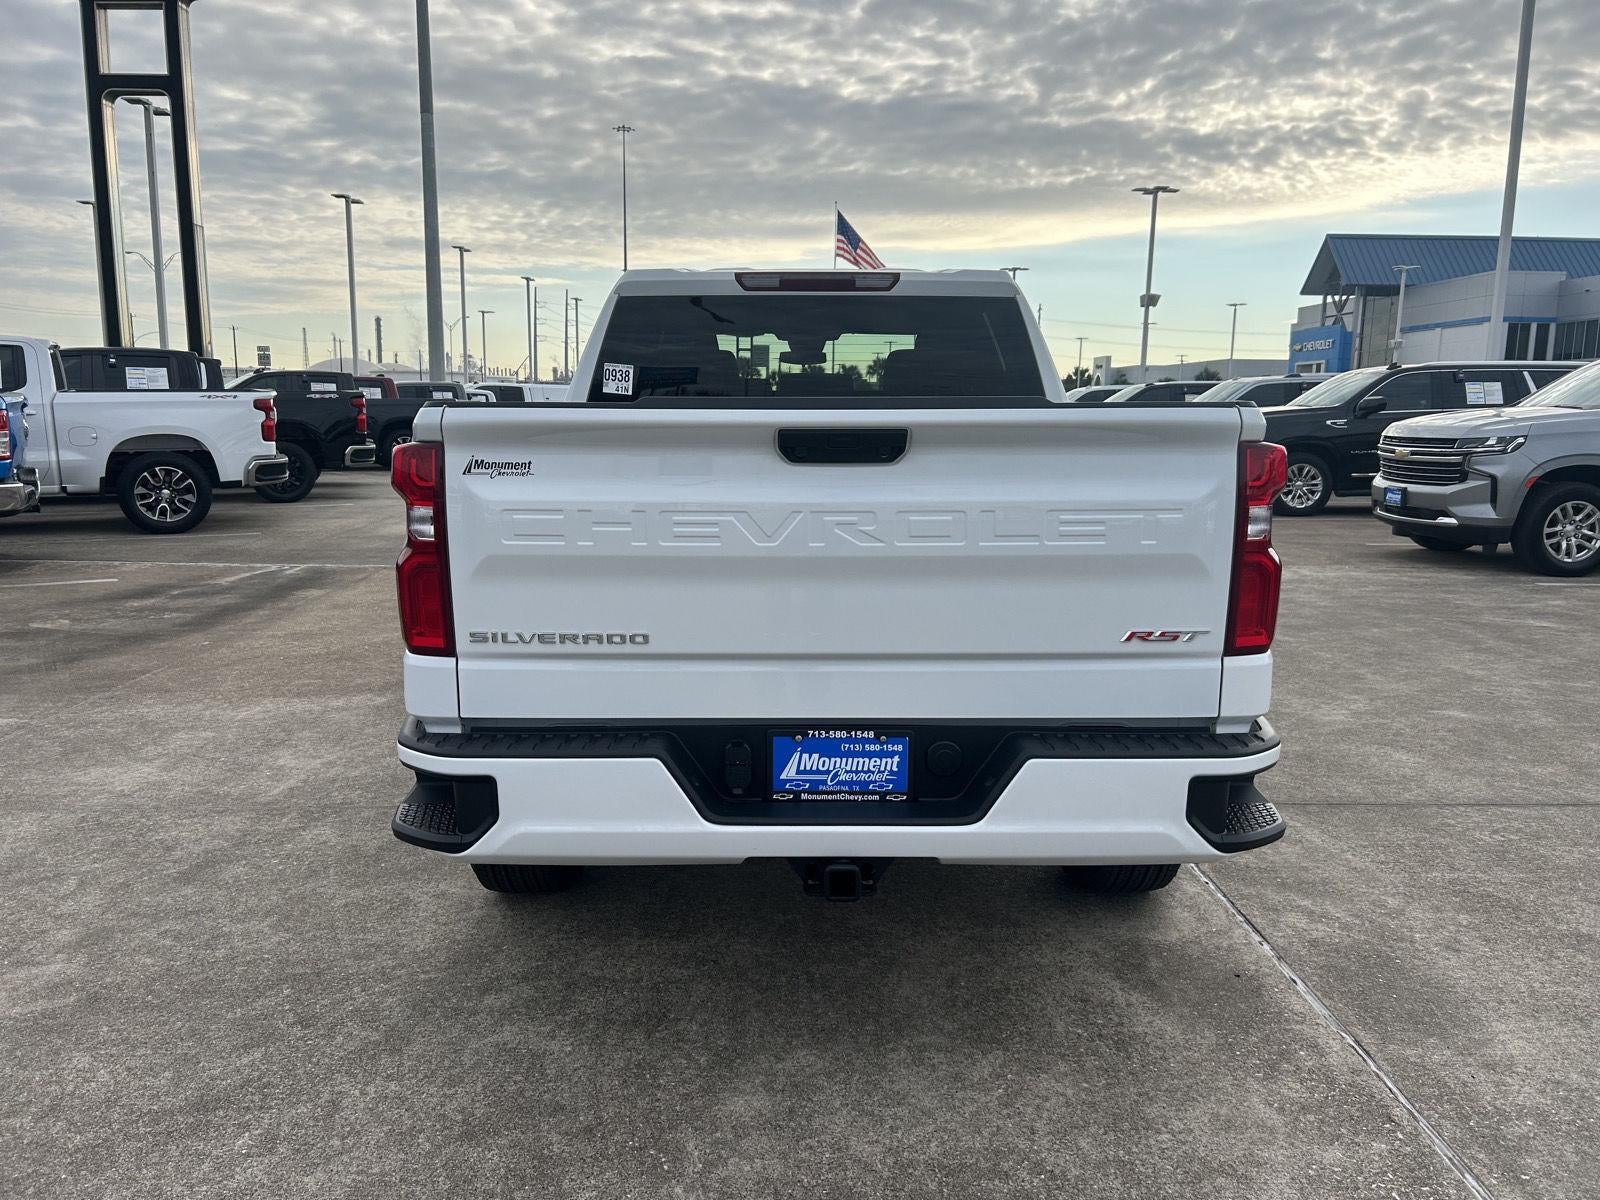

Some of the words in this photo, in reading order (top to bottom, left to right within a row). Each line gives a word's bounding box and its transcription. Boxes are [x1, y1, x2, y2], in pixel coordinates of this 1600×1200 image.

[604, 368, 631, 383] 0938
[615, 385, 629, 394] 41N
[473, 459, 533, 471] Monument
[490, 468, 534, 480] Chevrolet
[500, 508, 1185, 546] CHEVROLET
[469, 631, 650, 645] SILVERADO
[1120, 630, 1211, 643] RST
[807, 730, 875, 739] 713-580-1548
[841, 743, 862, 752] (713)
[864, 744, 903, 752] 580-1548
[799, 753, 900, 772] Monument
[827, 767, 889, 785] Chevrolet
[800, 792, 880, 802] MonumentChevy.com
